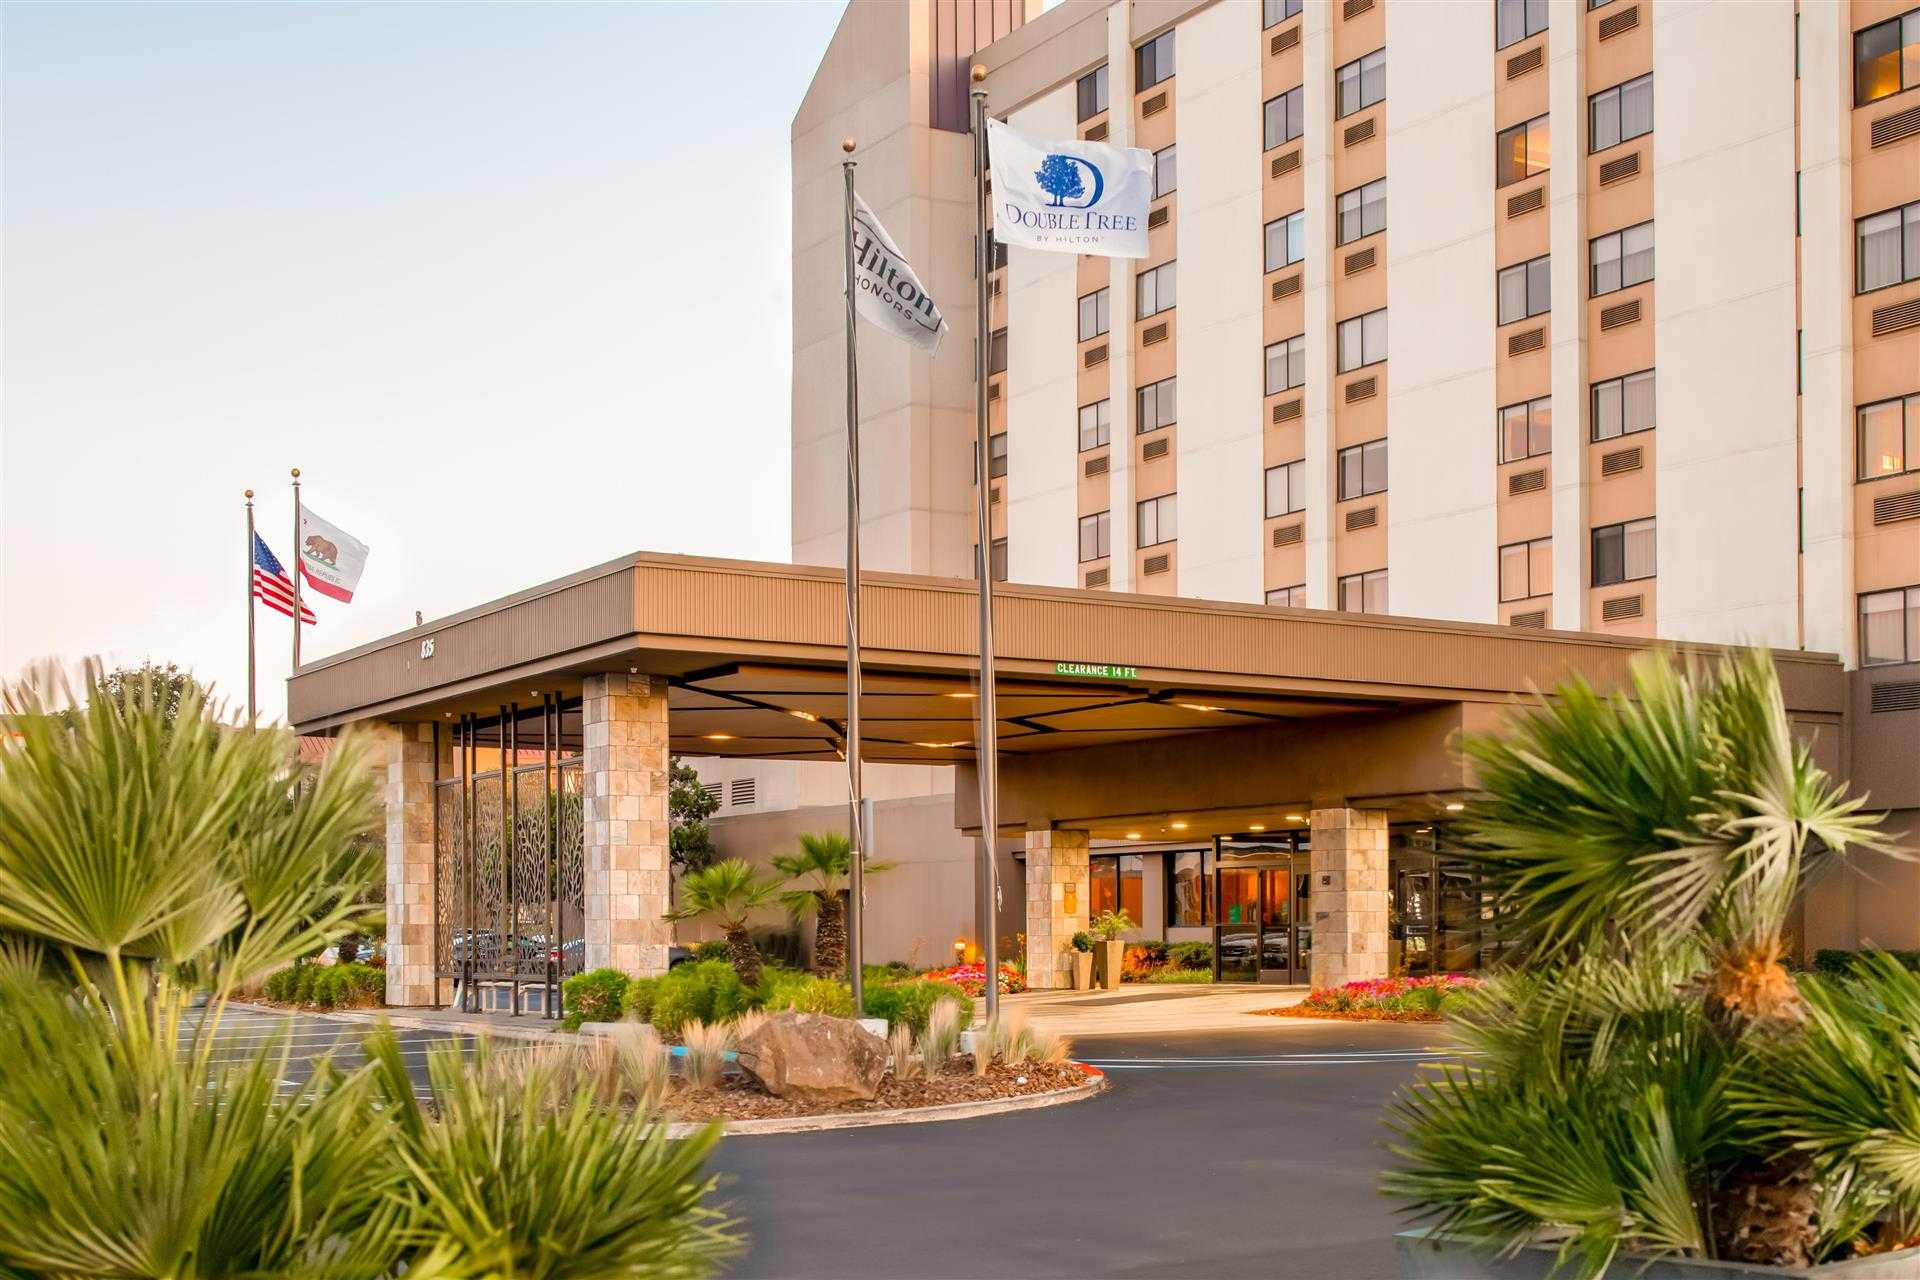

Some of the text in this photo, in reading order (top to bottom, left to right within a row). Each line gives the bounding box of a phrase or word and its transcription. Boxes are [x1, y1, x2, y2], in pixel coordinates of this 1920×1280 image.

[1055, 234, 1100, 244] HILTON
[853, 230, 936, 318] Hilton
[1057, 663, 1108, 676] CLEARANCE
[1112, 666, 1121, 677] 14
